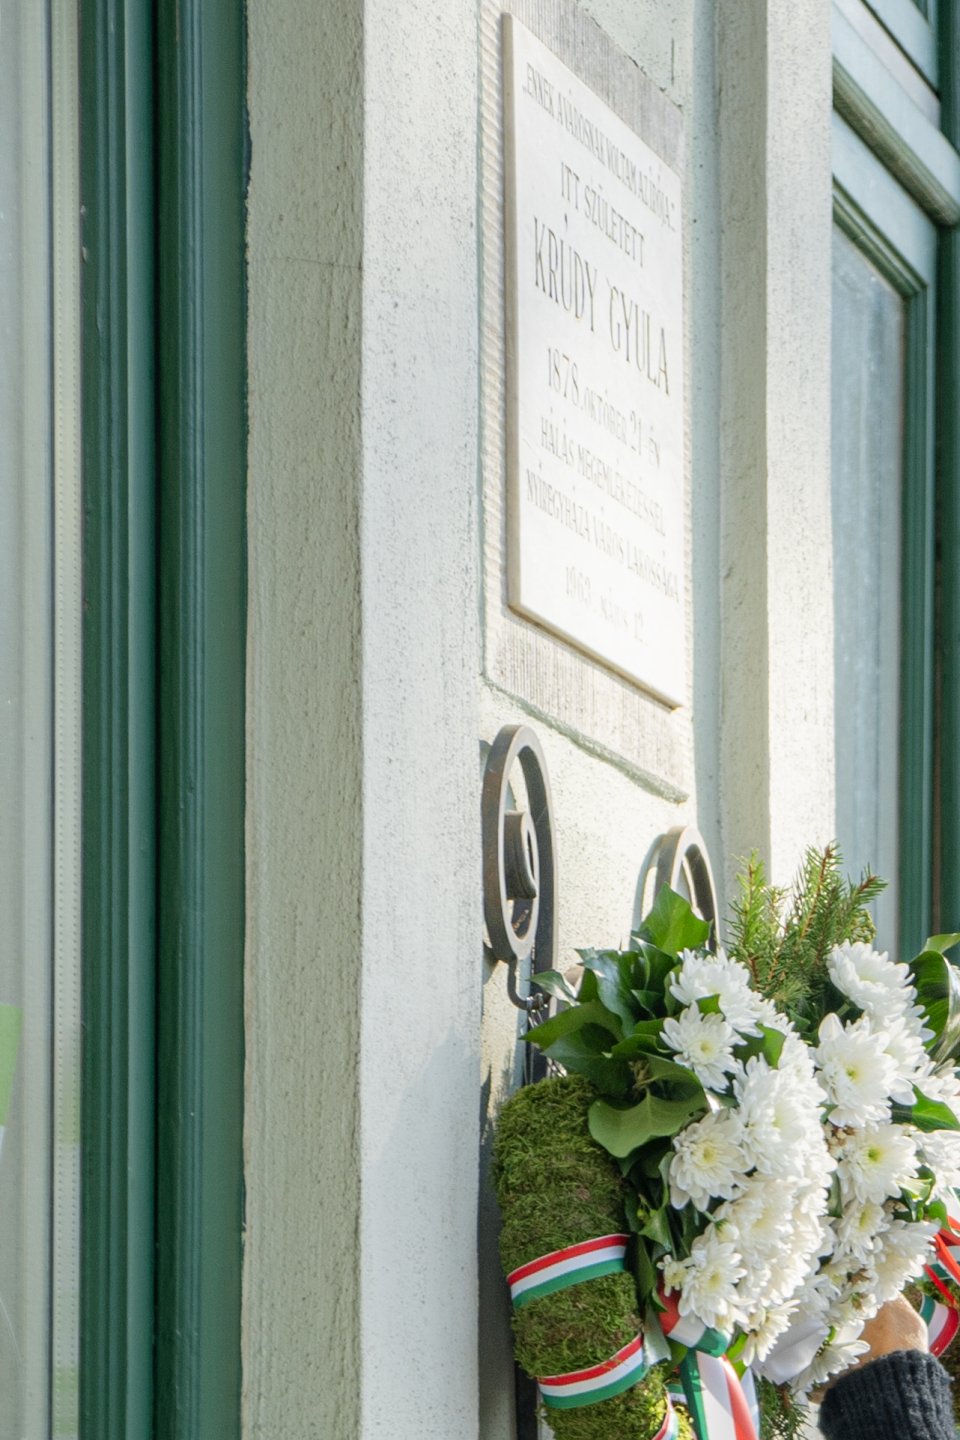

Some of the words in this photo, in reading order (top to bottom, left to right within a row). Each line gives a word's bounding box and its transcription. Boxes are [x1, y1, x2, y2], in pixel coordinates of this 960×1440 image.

[560, 163, 579, 209] ITT
[584, 181, 644, 267] SZÜLETETT
[533, 213, 597, 334] KRÚDY
[609, 284, 668, 393] GYULA
[540, 406, 574, 467] HÁLÁS
[584, 383, 626, 443] OKTÓBER
[526, 461, 590, 540] NYÍREGYHÁZA
[593, 506, 624, 564] VÁROS
